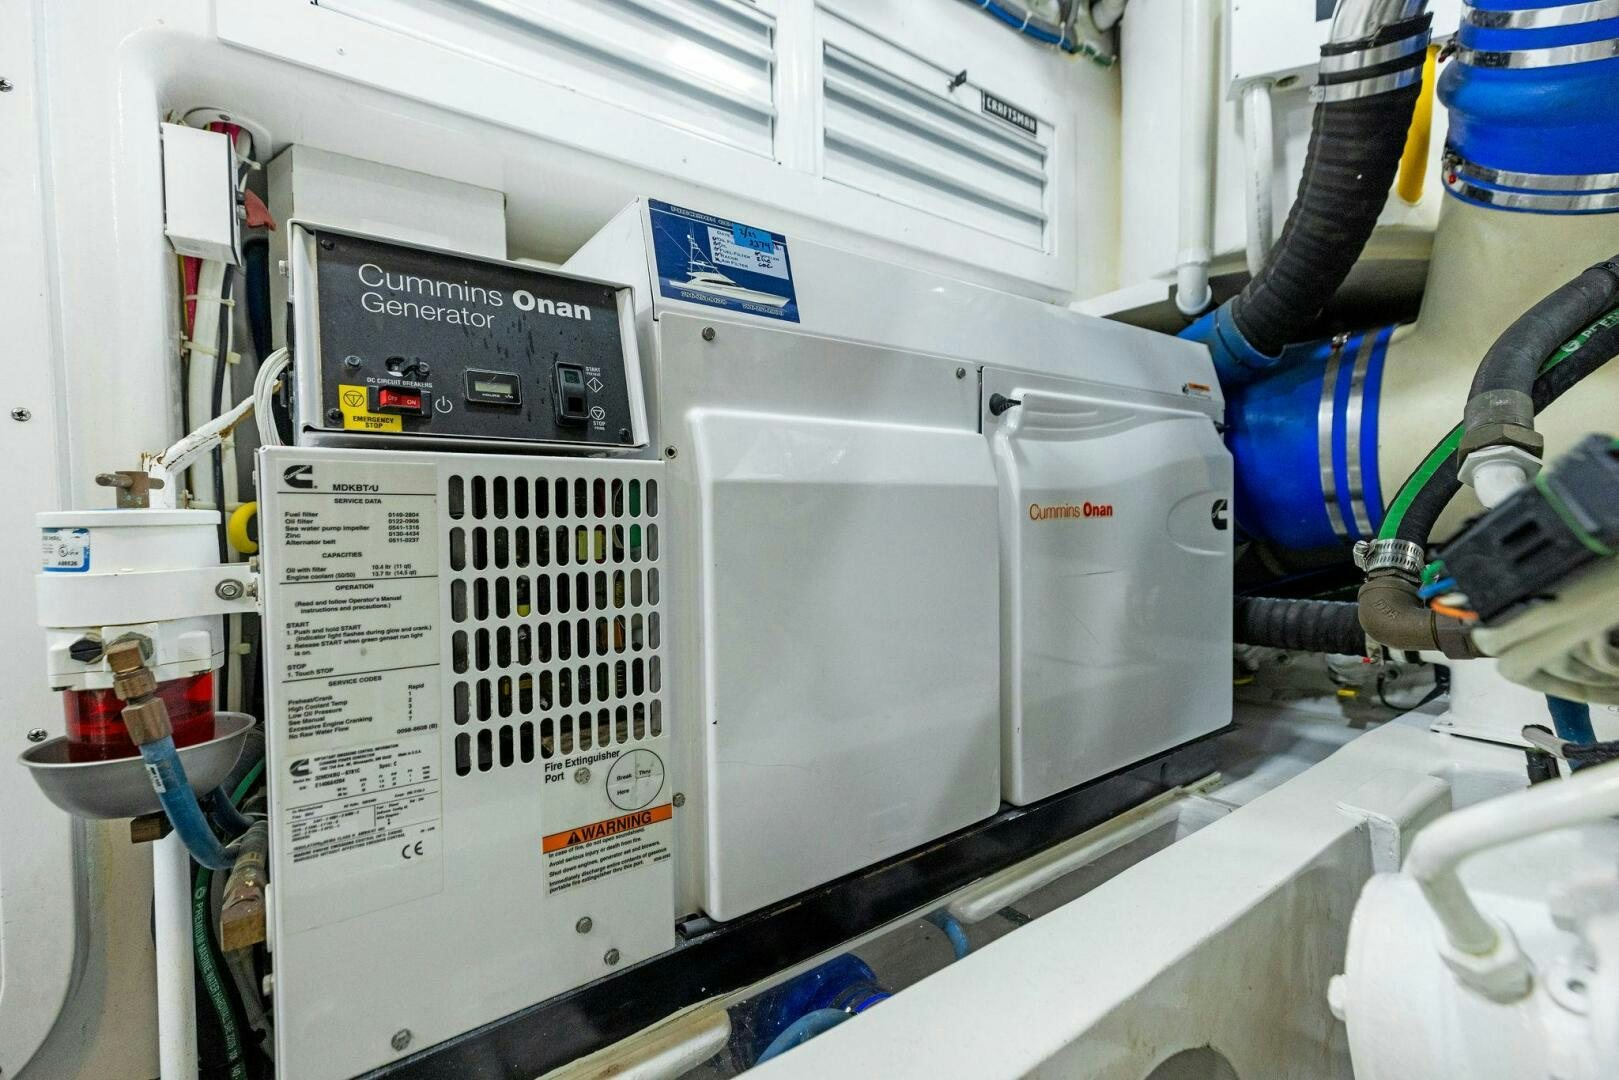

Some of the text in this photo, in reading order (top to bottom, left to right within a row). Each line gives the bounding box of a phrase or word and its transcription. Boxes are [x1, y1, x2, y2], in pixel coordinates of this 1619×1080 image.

[985, 96, 1036, 132] CRAFTSMAN
[358, 263, 592, 321] Cummins Onan
[361, 292, 496, 328] Generator
[1029, 502, 1113, 521] Cummins Onan
[341, 624, 361, 632] START
[328, 675, 382, 686] SERVICE CODES
[332, 699, 348, 707] Temp
[288, 724, 321, 733] Excessive
[323, 720, 344, 729] Engine
[345, 715, 373, 724] Cranking
[302, 716, 325, 724] Manual
[315, 728, 333, 736] Water
[544, 750, 620, 772] Fire Extinguisher
[545, 772, 564, 784] Port
[581, 812, 652, 841] WARNING
[549, 858, 564, 867] Avoid
[566, 854, 584, 862] serious
[549, 869, 561, 877] Shut
[563, 865, 576, 873] down
[600, 852, 623, 863] generator
[581, 865, 606, 876] discharge
[621, 855, 641, 864] contents
[549, 883, 571, 894] portable
[582, 870, 612, 883] extinguisher
